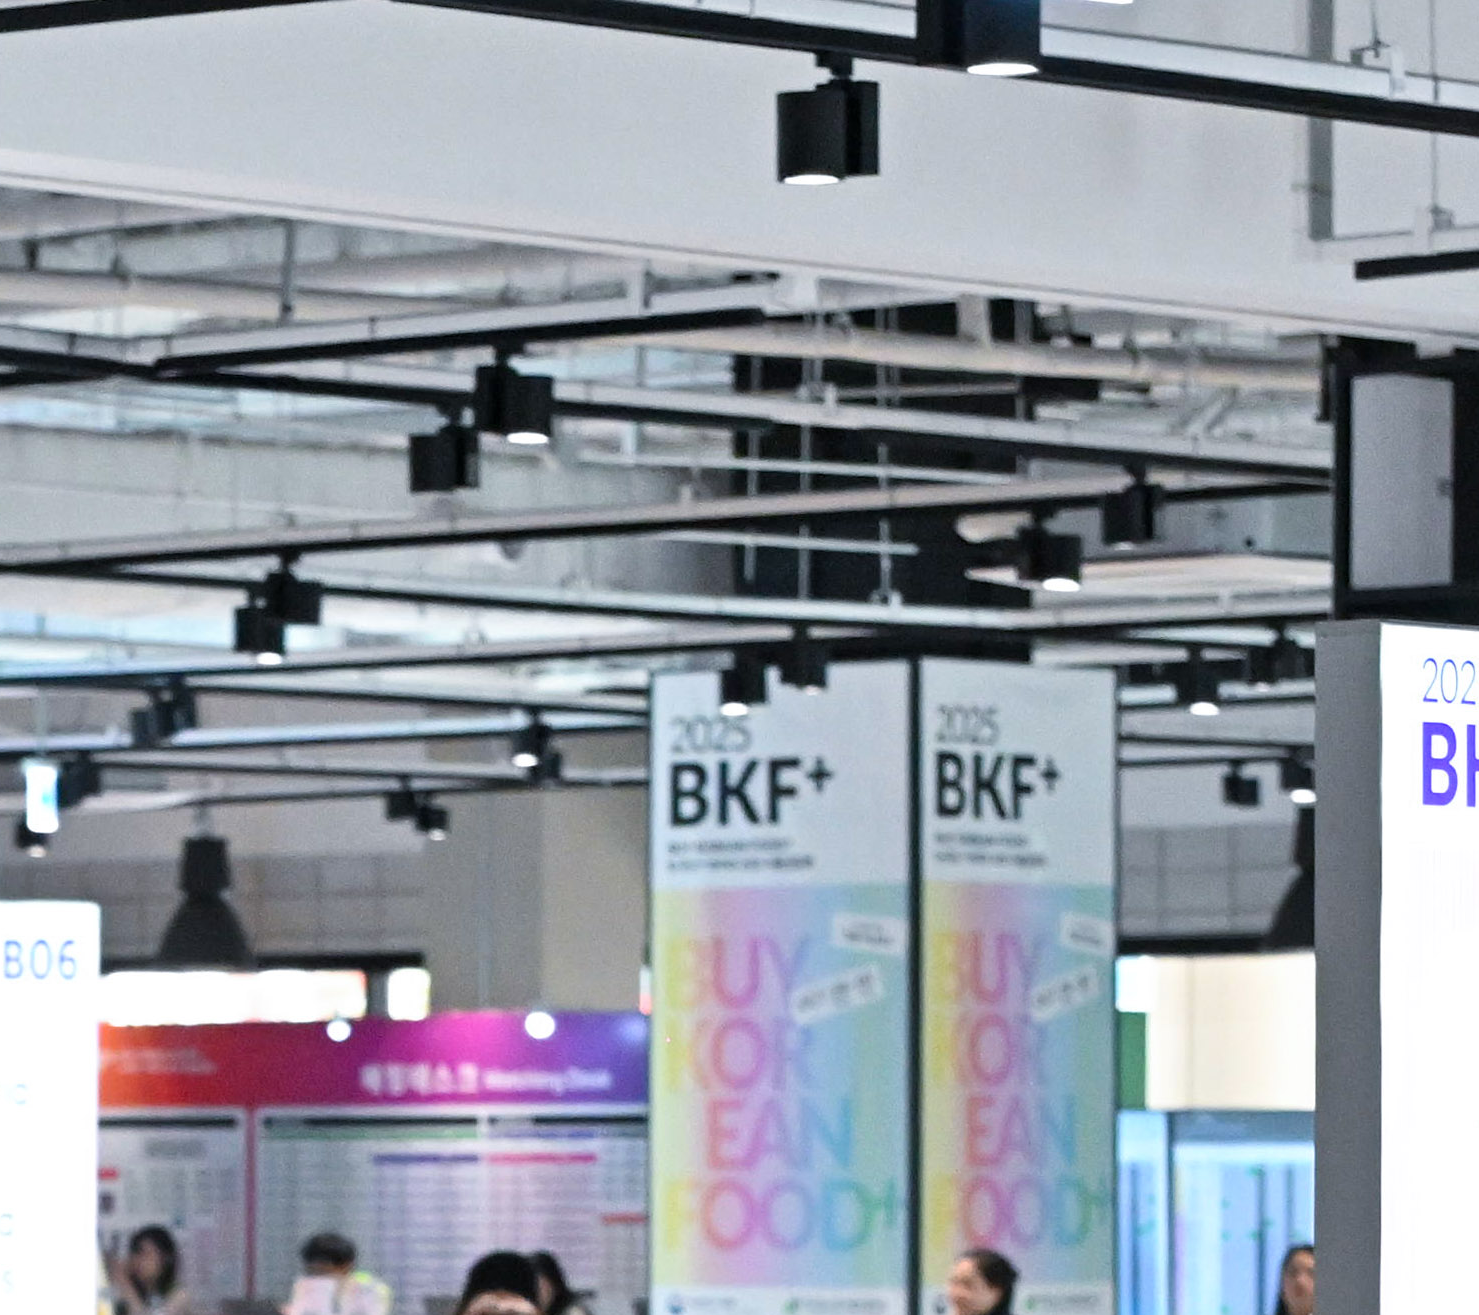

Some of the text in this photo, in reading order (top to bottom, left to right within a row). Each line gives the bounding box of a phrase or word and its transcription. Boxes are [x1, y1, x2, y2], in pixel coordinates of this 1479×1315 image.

[670, 715, 752, 754] 2025
[936, 703, 1000, 745] 2025
[668, 756, 834, 828] BKF+
[935, 752, 1062, 822] BKF+
[2, 938, 78, 981] B06
